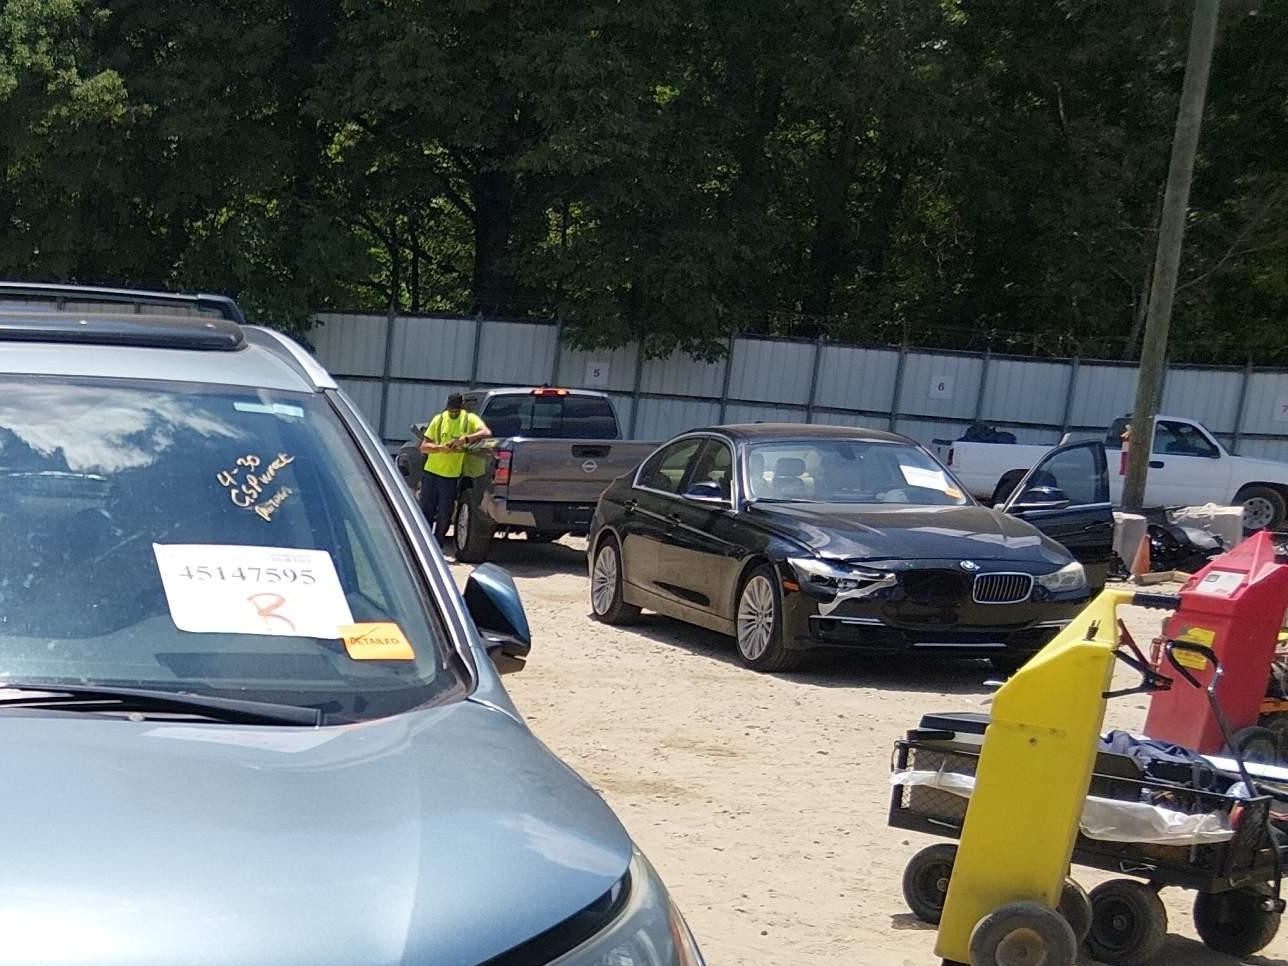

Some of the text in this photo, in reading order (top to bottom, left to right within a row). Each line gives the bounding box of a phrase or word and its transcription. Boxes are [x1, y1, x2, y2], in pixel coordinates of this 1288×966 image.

[593, 368, 601, 378] 5
[937, 382, 945, 391] 6
[178, 564, 317, 585] 45147595
